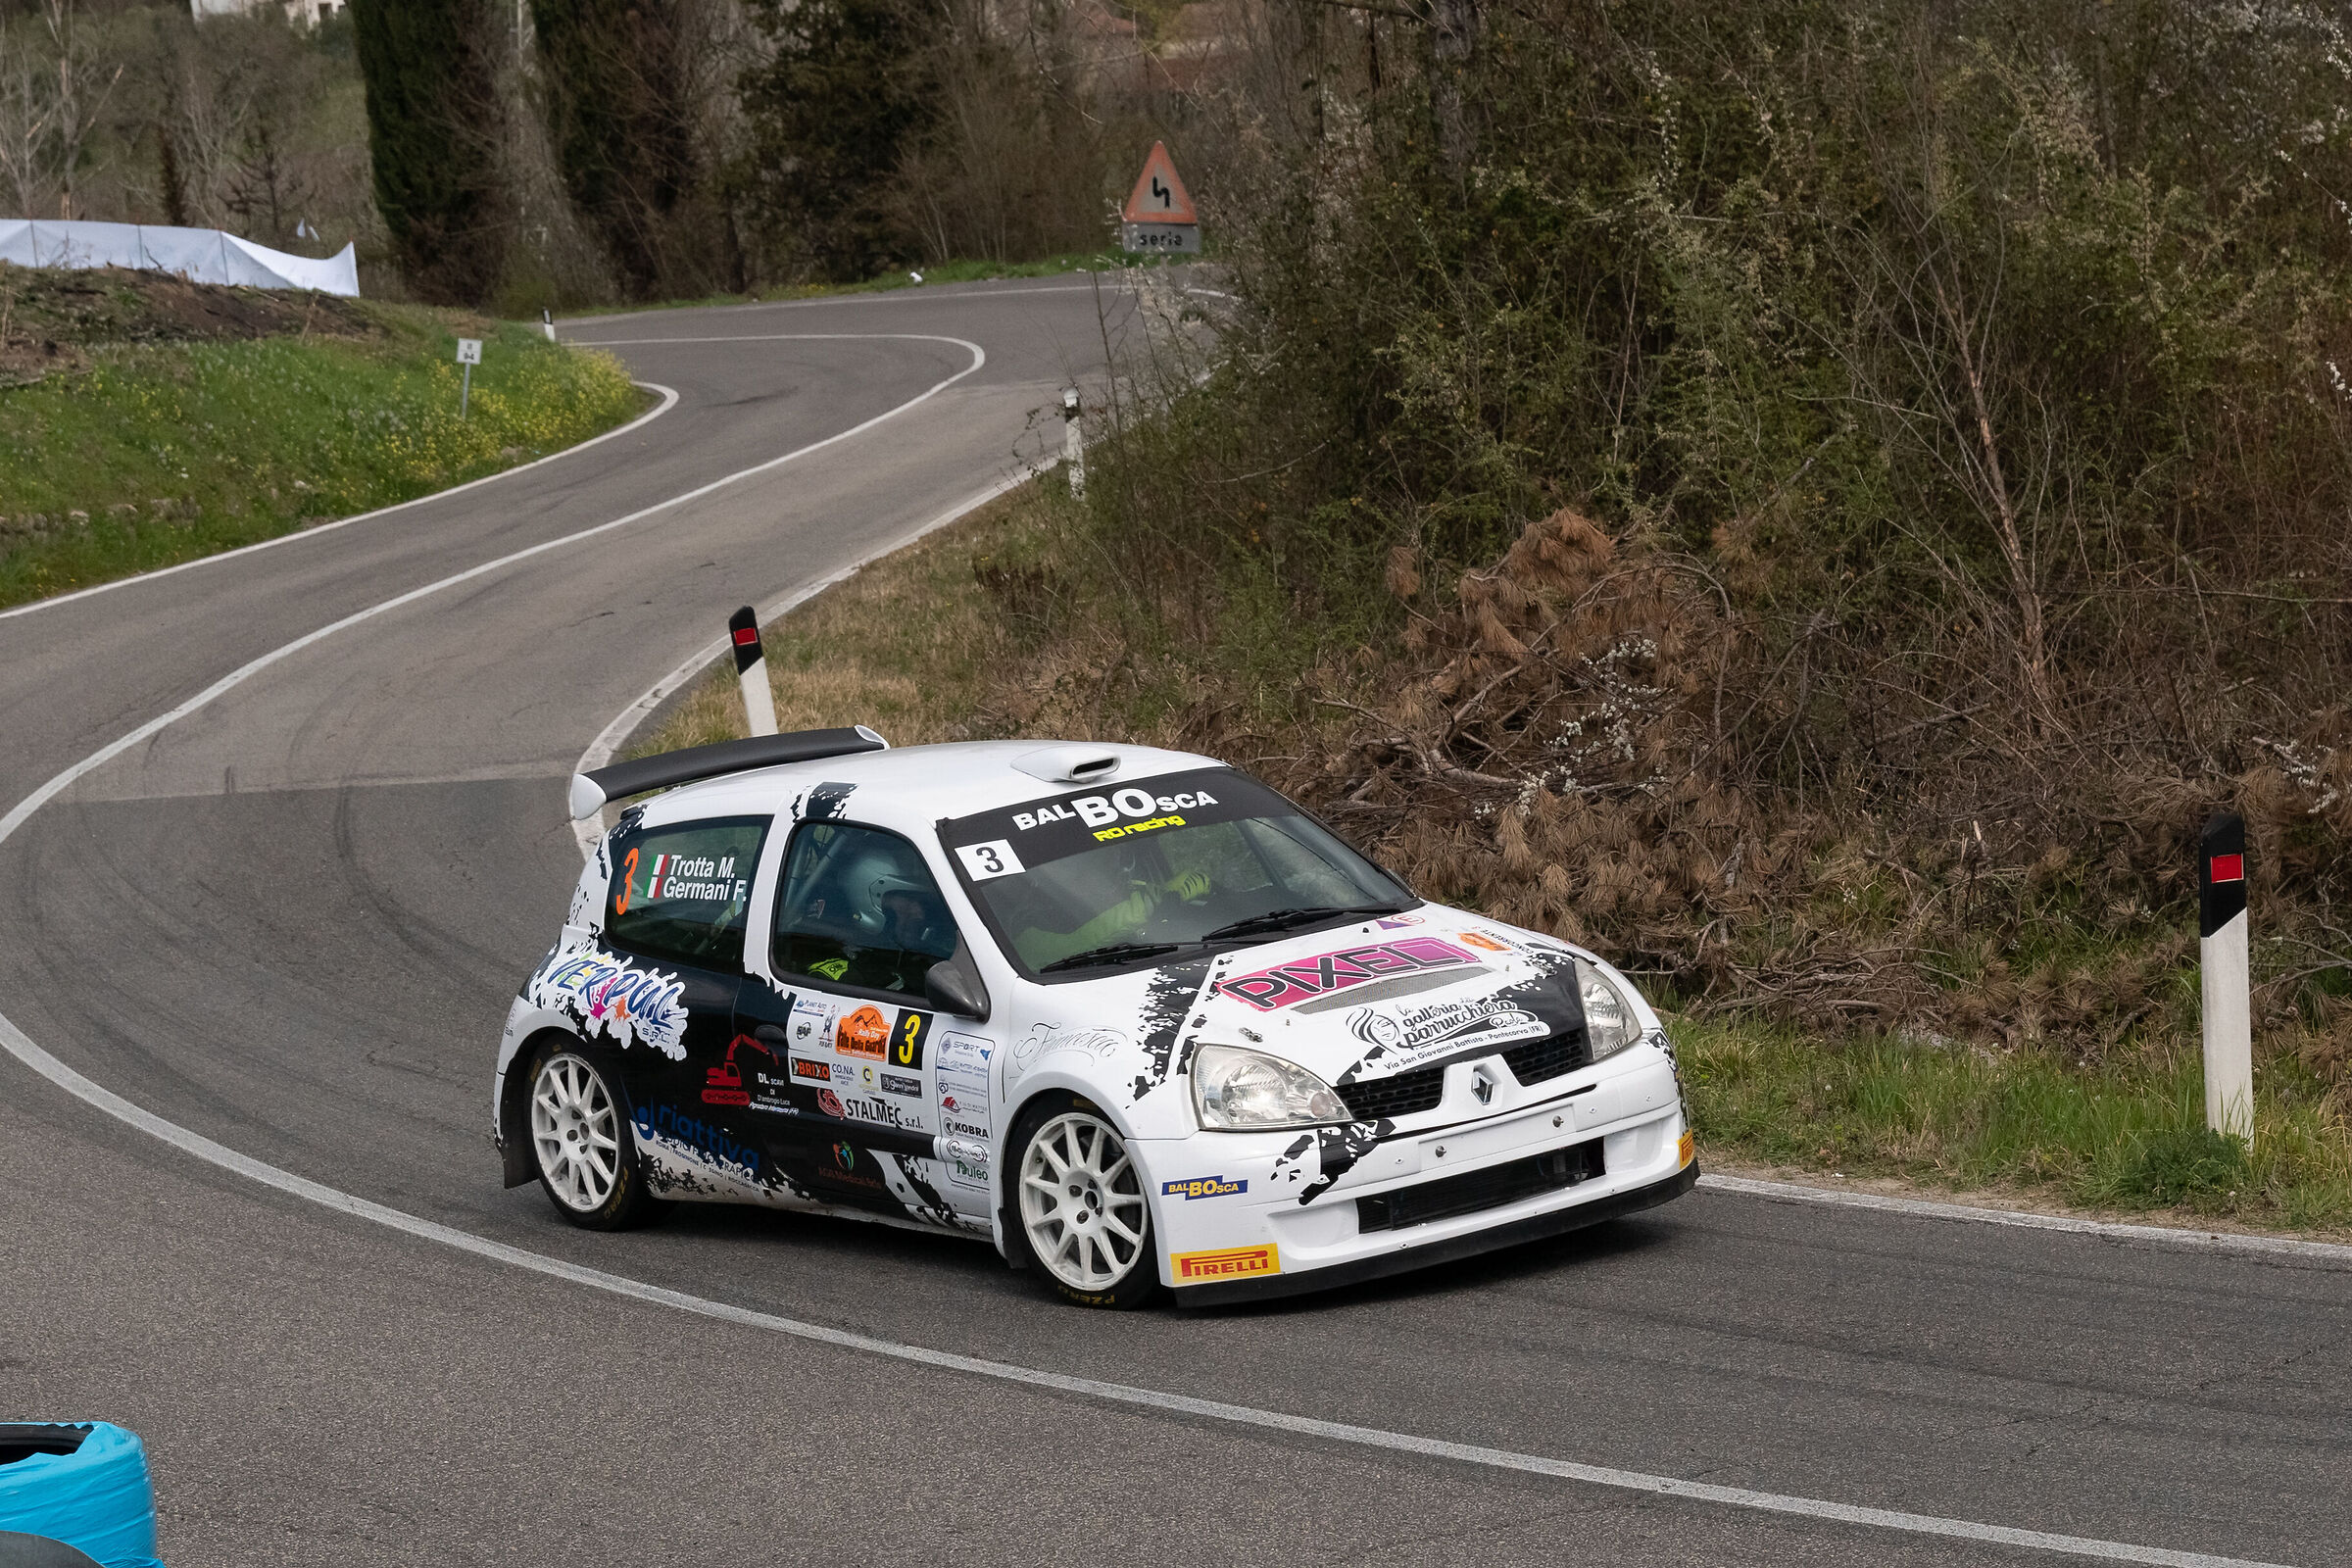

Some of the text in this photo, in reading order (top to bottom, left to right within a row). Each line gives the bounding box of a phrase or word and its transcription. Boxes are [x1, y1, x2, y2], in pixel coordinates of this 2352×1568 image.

[1139, 231, 1183, 246] serie
[1011, 788, 1219, 831] BALBOSCA
[1124, 814, 1187, 835] racing
[669, 855, 736, 879] Trotta M.
[975, 846, 1004, 873] 3
[615, 847, 639, 915] 3
[662, 876, 748, 903] Germani F.
[1221, 945, 1466, 1008] PIXEL
[1396, 999, 1519, 1051] parrucchiera
[899, 1014, 921, 1064] 3
[953, 1041, 980, 1052] SPORT
[1384, 1060, 1399, 1071] Via
[1399, 1054, 1417, 1065] San
[1417, 1043, 1454, 1059] Giovanni
[1454, 1035, 1485, 1049] Battista
[1488, 1027, 1530, 1041] Pontecorvo
[1529, 1024, 1544, 1035] (FR)
[758, 1072, 769, 1085] DL
[798, 1062, 830, 1079] BRIXO
[832, 1063, 856, 1076] CO.NA.
[846, 1099, 924, 1129] STALMEC s.r.l.
[659, 1104, 760, 1172] riattiva
[955, 1121, 990, 1139] KOBRA
[1168, 1179, 1240, 1197] BALBOSCA
[1180, 1250, 1269, 1278] PIRELLI
